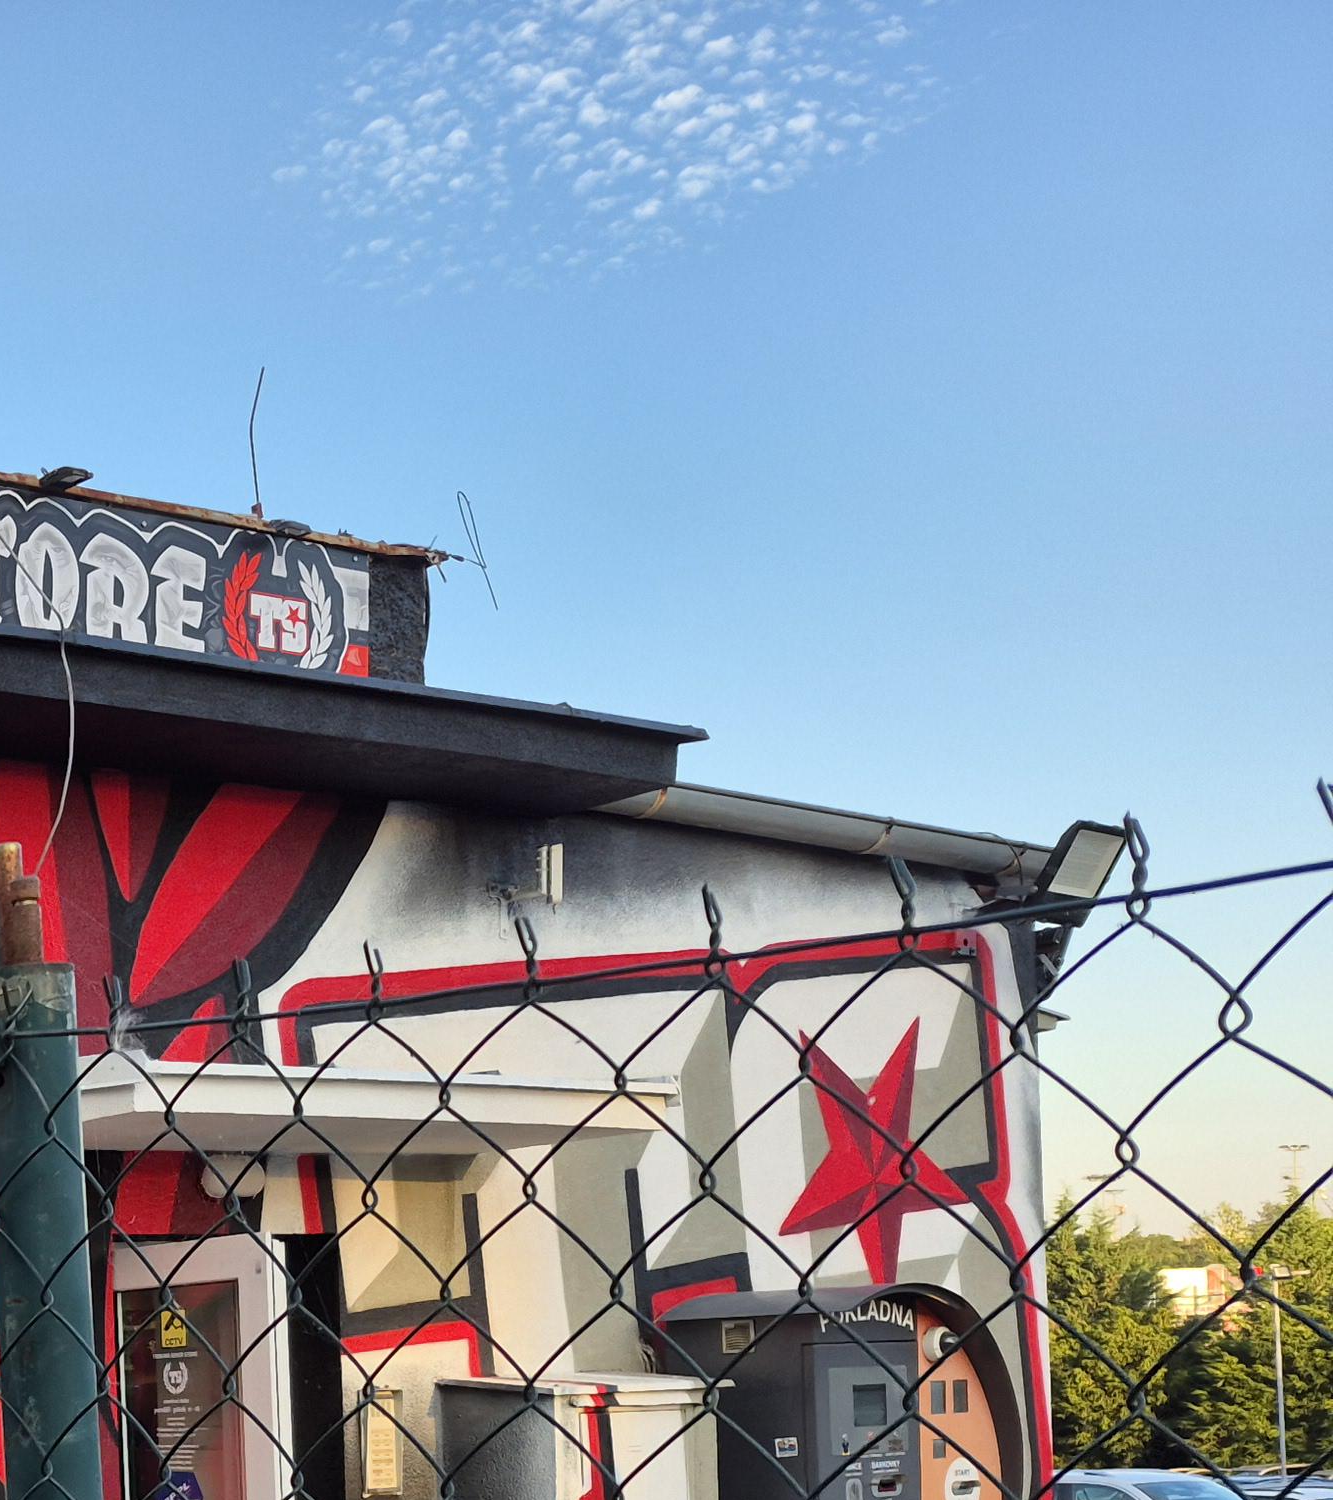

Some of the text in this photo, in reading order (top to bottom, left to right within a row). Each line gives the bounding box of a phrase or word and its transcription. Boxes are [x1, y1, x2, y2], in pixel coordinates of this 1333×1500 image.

[250, 592, 308, 655] TS
[164, 1337, 184, 1346] CCTV
[954, 1468, 971, 1477] START
